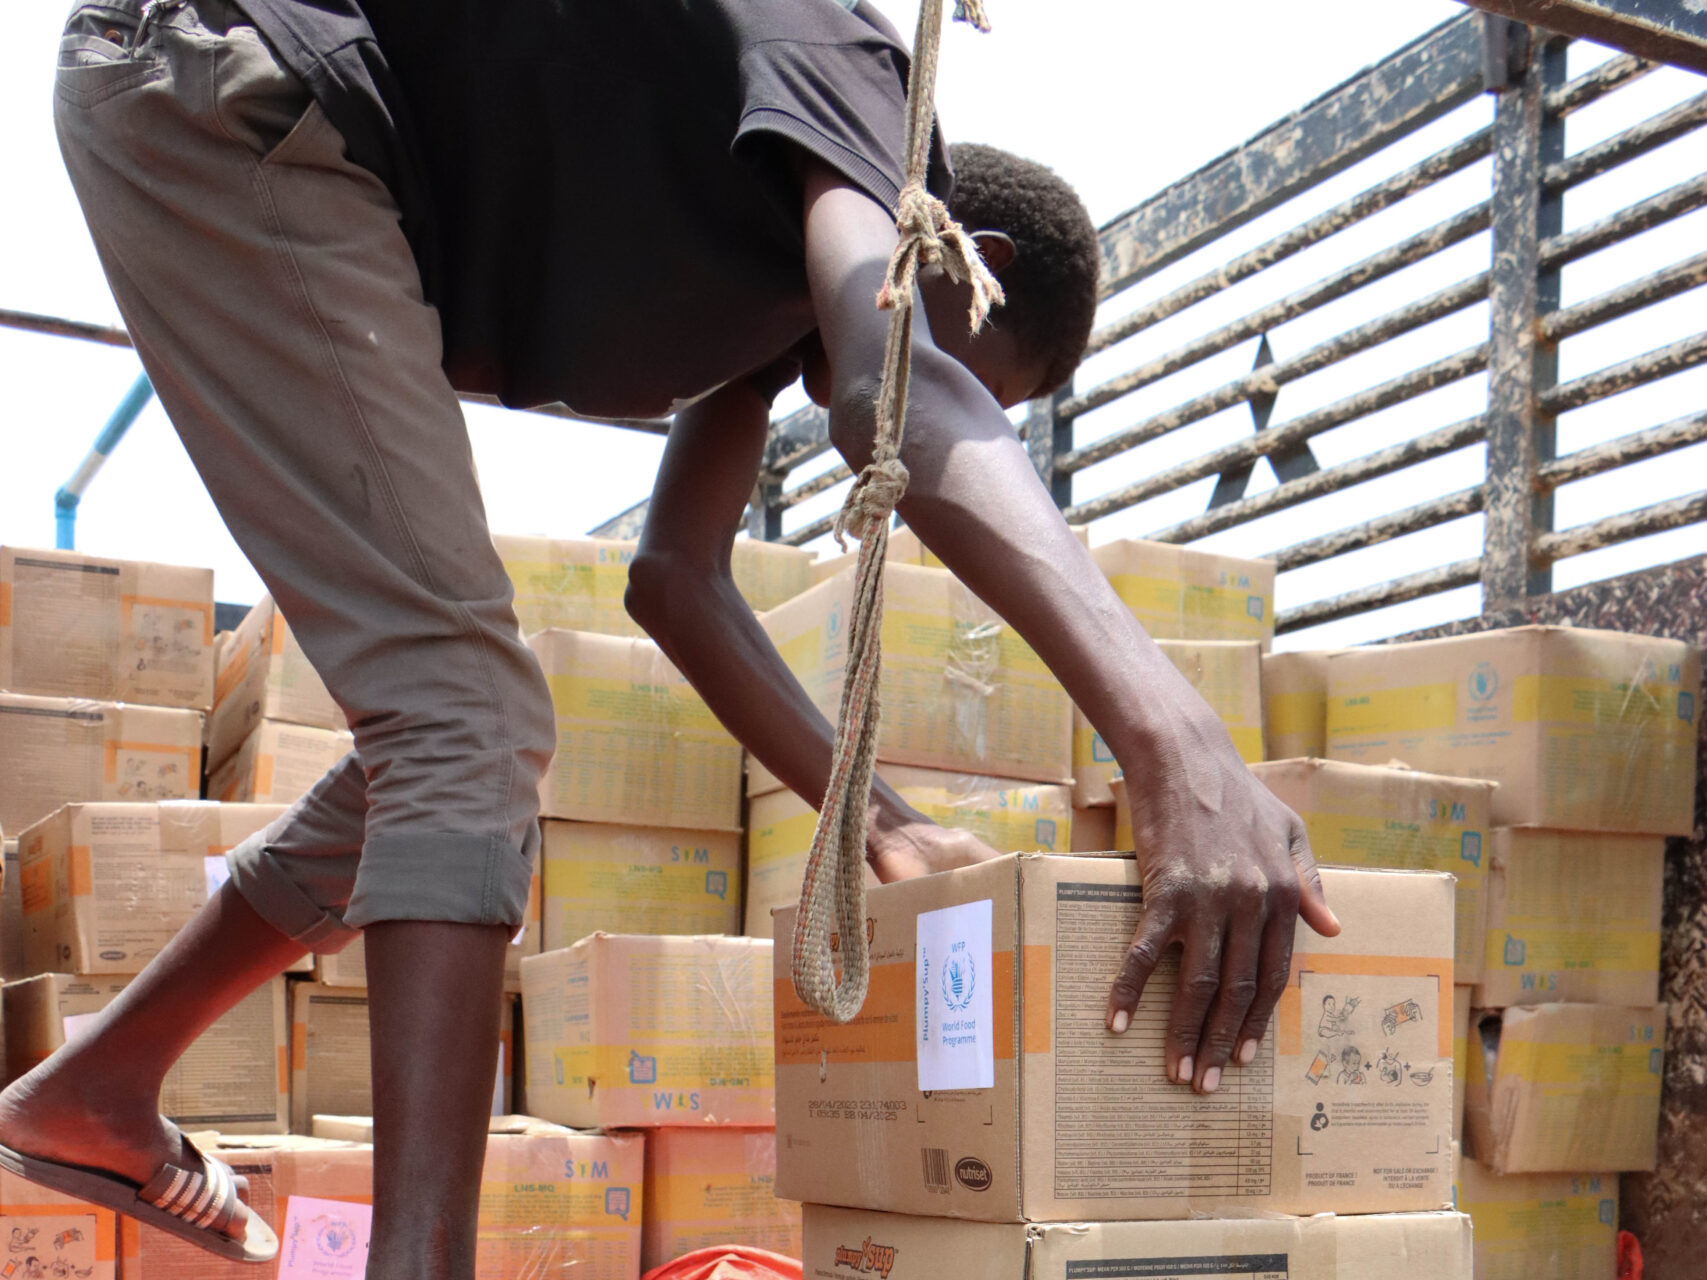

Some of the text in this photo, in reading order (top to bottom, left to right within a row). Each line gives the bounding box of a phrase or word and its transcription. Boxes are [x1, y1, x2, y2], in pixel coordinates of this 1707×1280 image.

[942, 1020, 976, 1033] World Food
[942, 1035, 976, 1048] Programme
